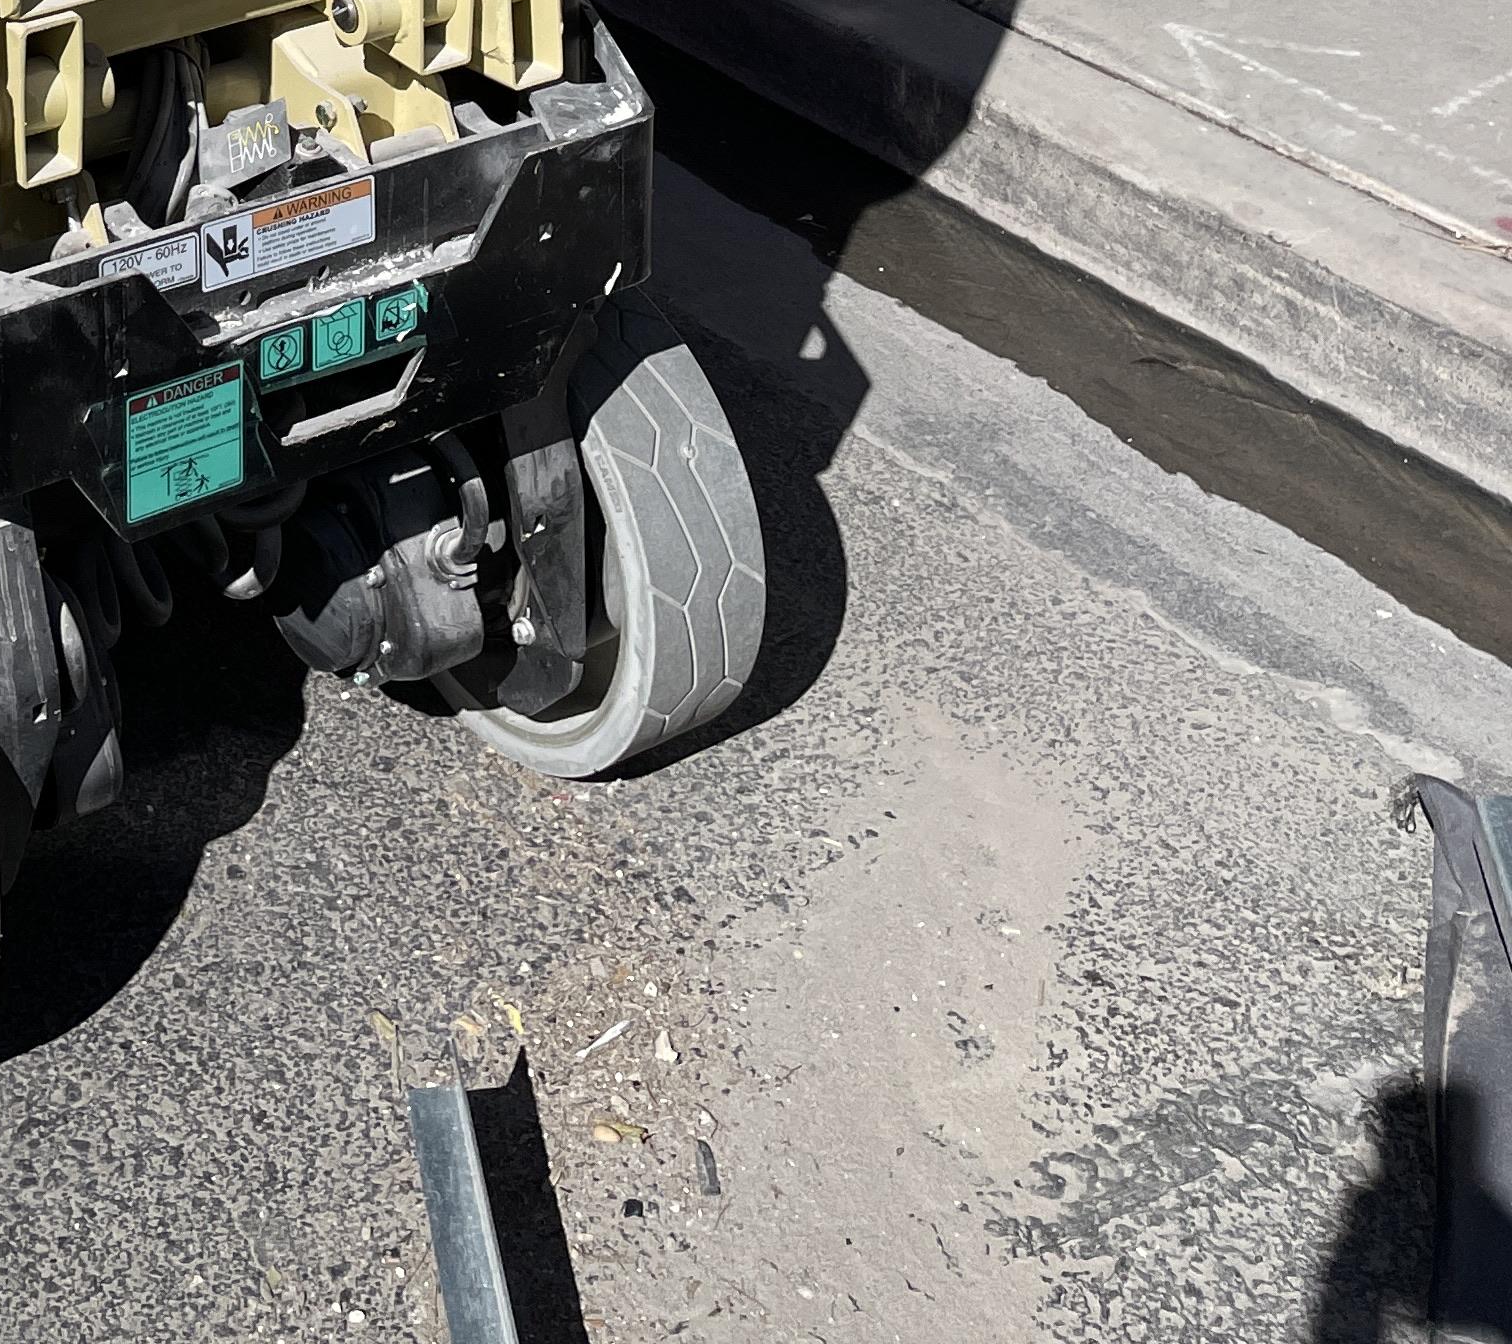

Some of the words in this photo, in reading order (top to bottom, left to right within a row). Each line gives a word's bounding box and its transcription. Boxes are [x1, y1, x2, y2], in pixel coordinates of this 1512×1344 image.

[287, 188, 352, 215] WARNING
[257, 219, 296, 235] CRUSHING
[299, 209, 330, 223] HAZARD
[112, 253, 143, 273] 120V
[155, 243, 187, 261] 60Hz
[170, 263, 183, 272] TO
[163, 372, 224, 402] DANGER
